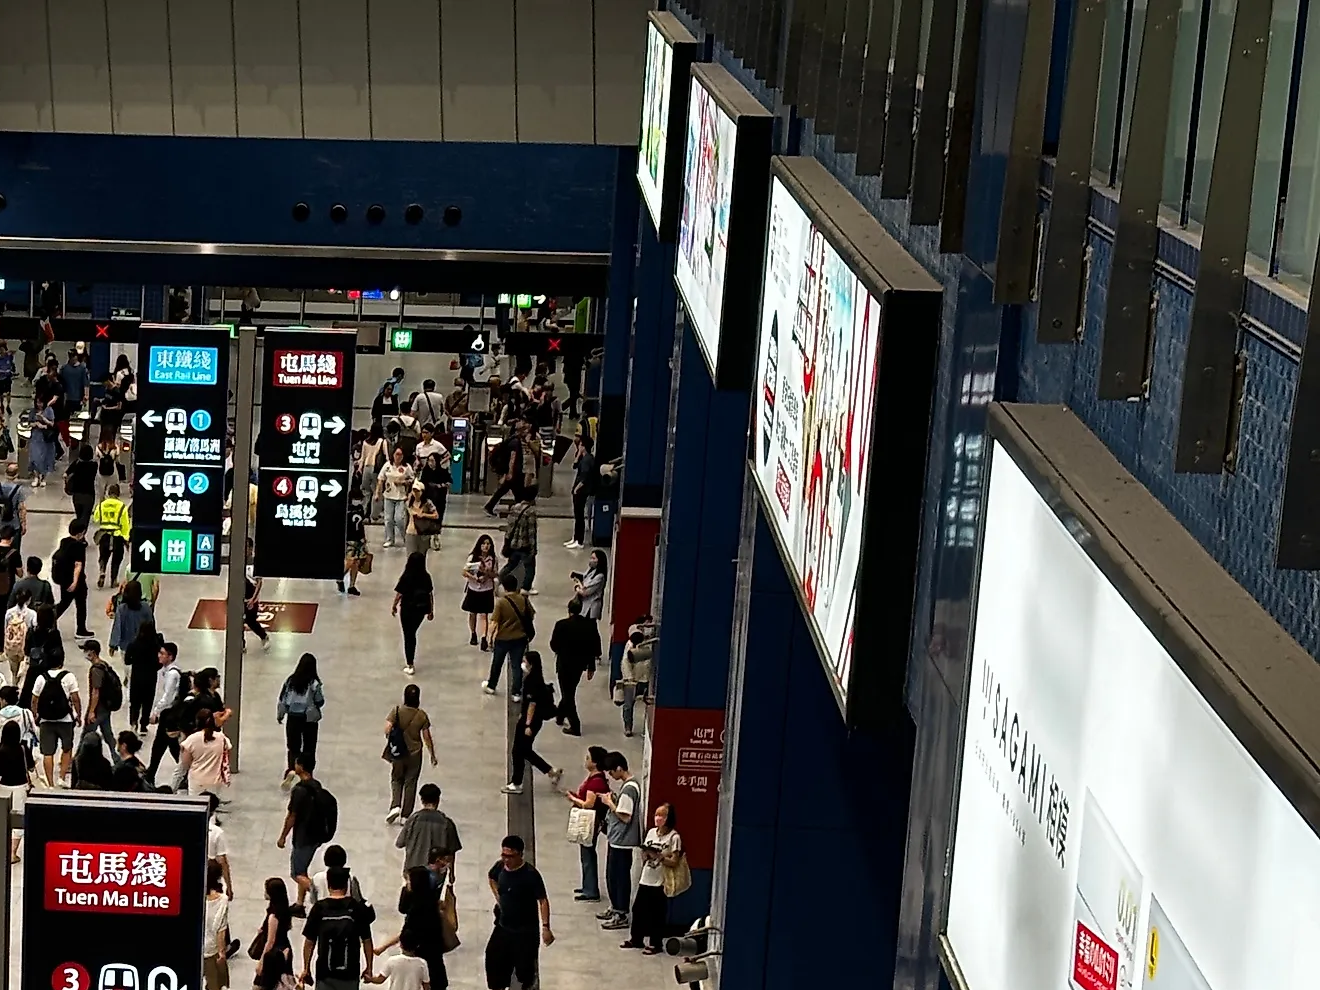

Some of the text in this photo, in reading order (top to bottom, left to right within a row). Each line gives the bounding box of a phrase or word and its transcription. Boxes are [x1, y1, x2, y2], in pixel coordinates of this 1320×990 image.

[156, 349, 212, 371] 東鐵綫
[280, 353, 337, 375] 屯馬綫
[154, 370, 212, 381] East Rail Line
[278, 373, 338, 386] Tuen Ma Line
[197, 413, 204, 427] 1
[280, 415, 291, 431] 3
[292, 441, 320, 457] 屯門
[193, 476, 203, 490] 2
[276, 479, 289, 495] 4
[200, 537, 211, 549] A
[200, 556, 210, 568] B
[992, 682, 1047, 825] SAGAMI
[58, 850, 168, 889] 屯馬綫
[54, 888, 171, 910] Tuen Ma Line
